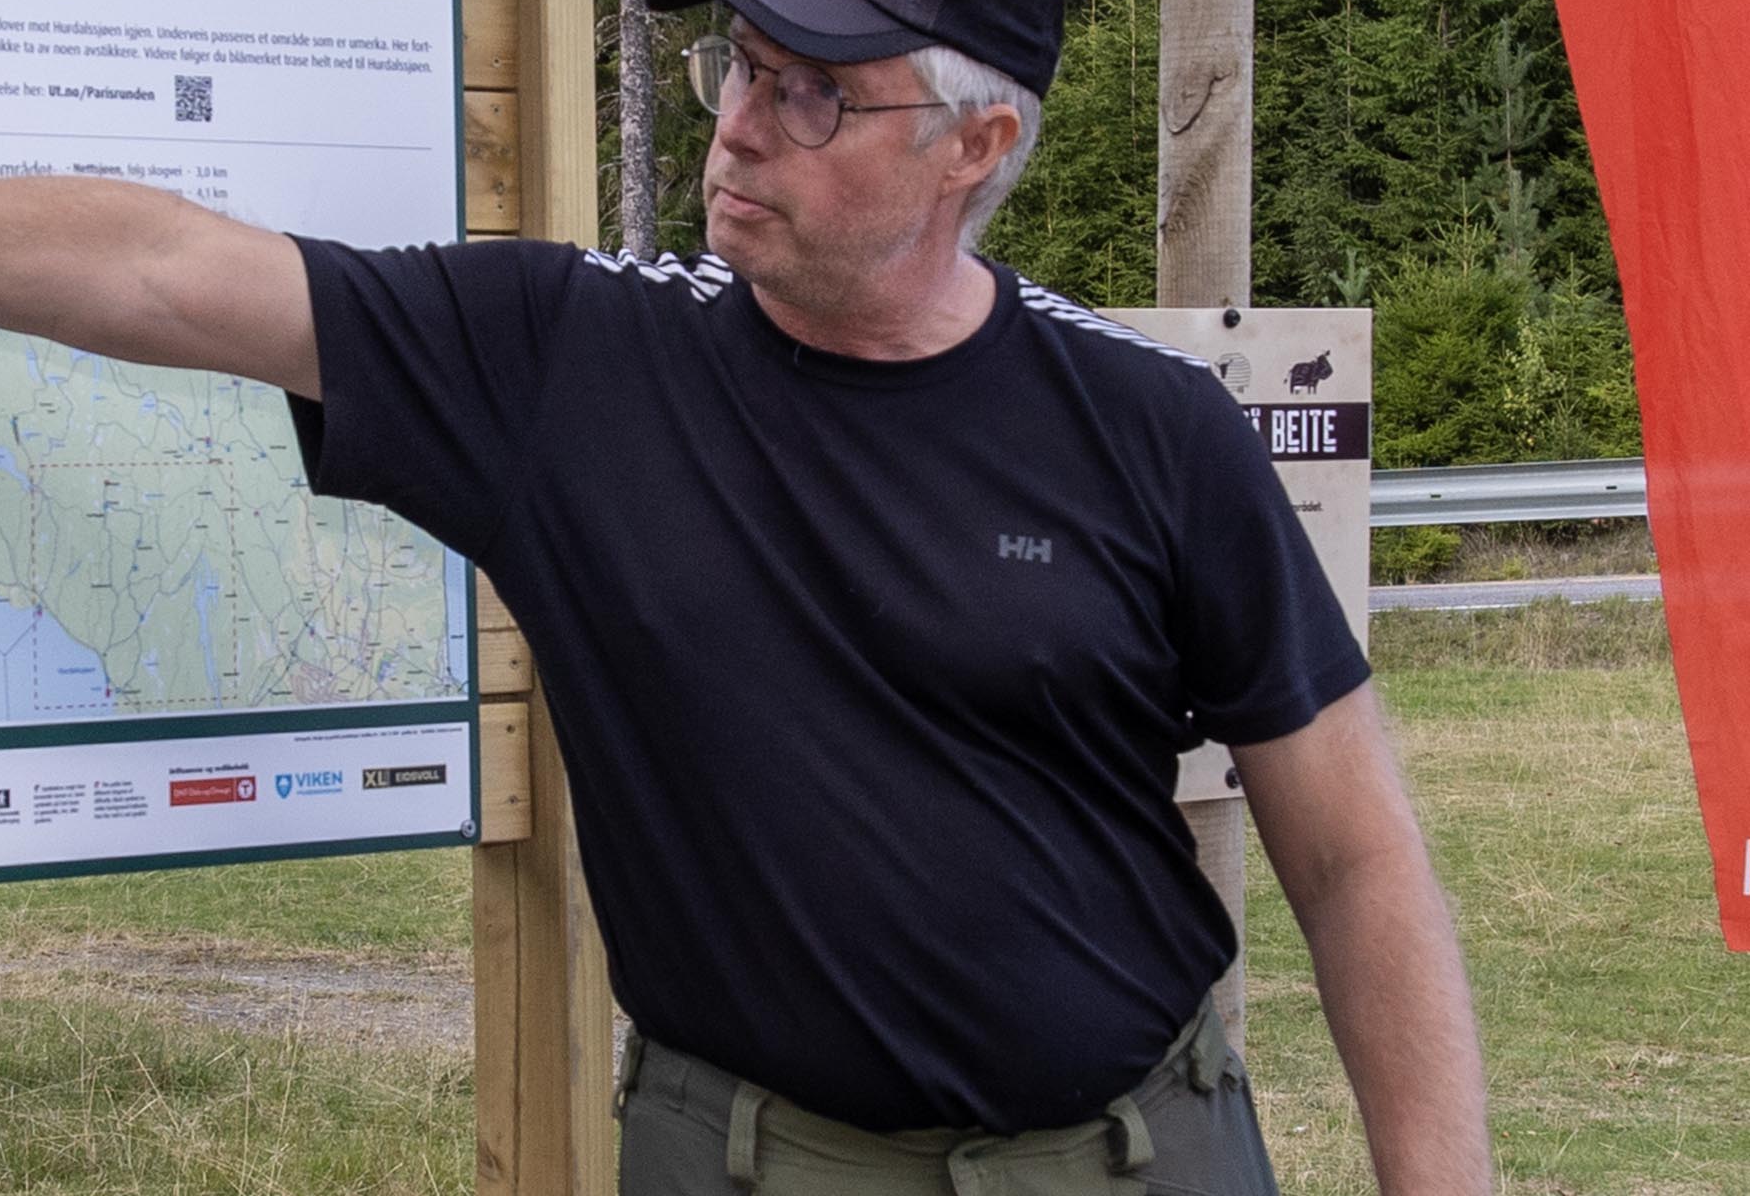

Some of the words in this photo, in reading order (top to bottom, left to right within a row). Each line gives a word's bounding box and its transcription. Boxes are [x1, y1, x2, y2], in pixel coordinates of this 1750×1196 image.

[28, 22, 50, 33] mot
[52, 22, 121, 39] Hurdalssjøen
[124, 25, 152, 40] igjen.
[156, 27, 208, 40] Underveis
[211, 32, 255, 45] passeres
[258, 33, 268, 43] et
[271, 31, 309, 45] område
[312, 37, 333, 46] som
[336, 38, 346, 47] er
[348, 36, 387, 49] umerka.
[391, 38, 408, 50] Her
[411, 39, 432, 51] fort-
[23, 84, 43, 96] her:
[48, 86, 155, 103] Ut.no/Parisrunden
[195, 166, 210, 179] 3,0
[213, 166, 228, 178] km
[213, 187, 228, 198] km
[1272, 410, 1337, 454] BEITE
[999, 535, 1051, 562] HH
[295, 771, 343, 788] VIKEN
